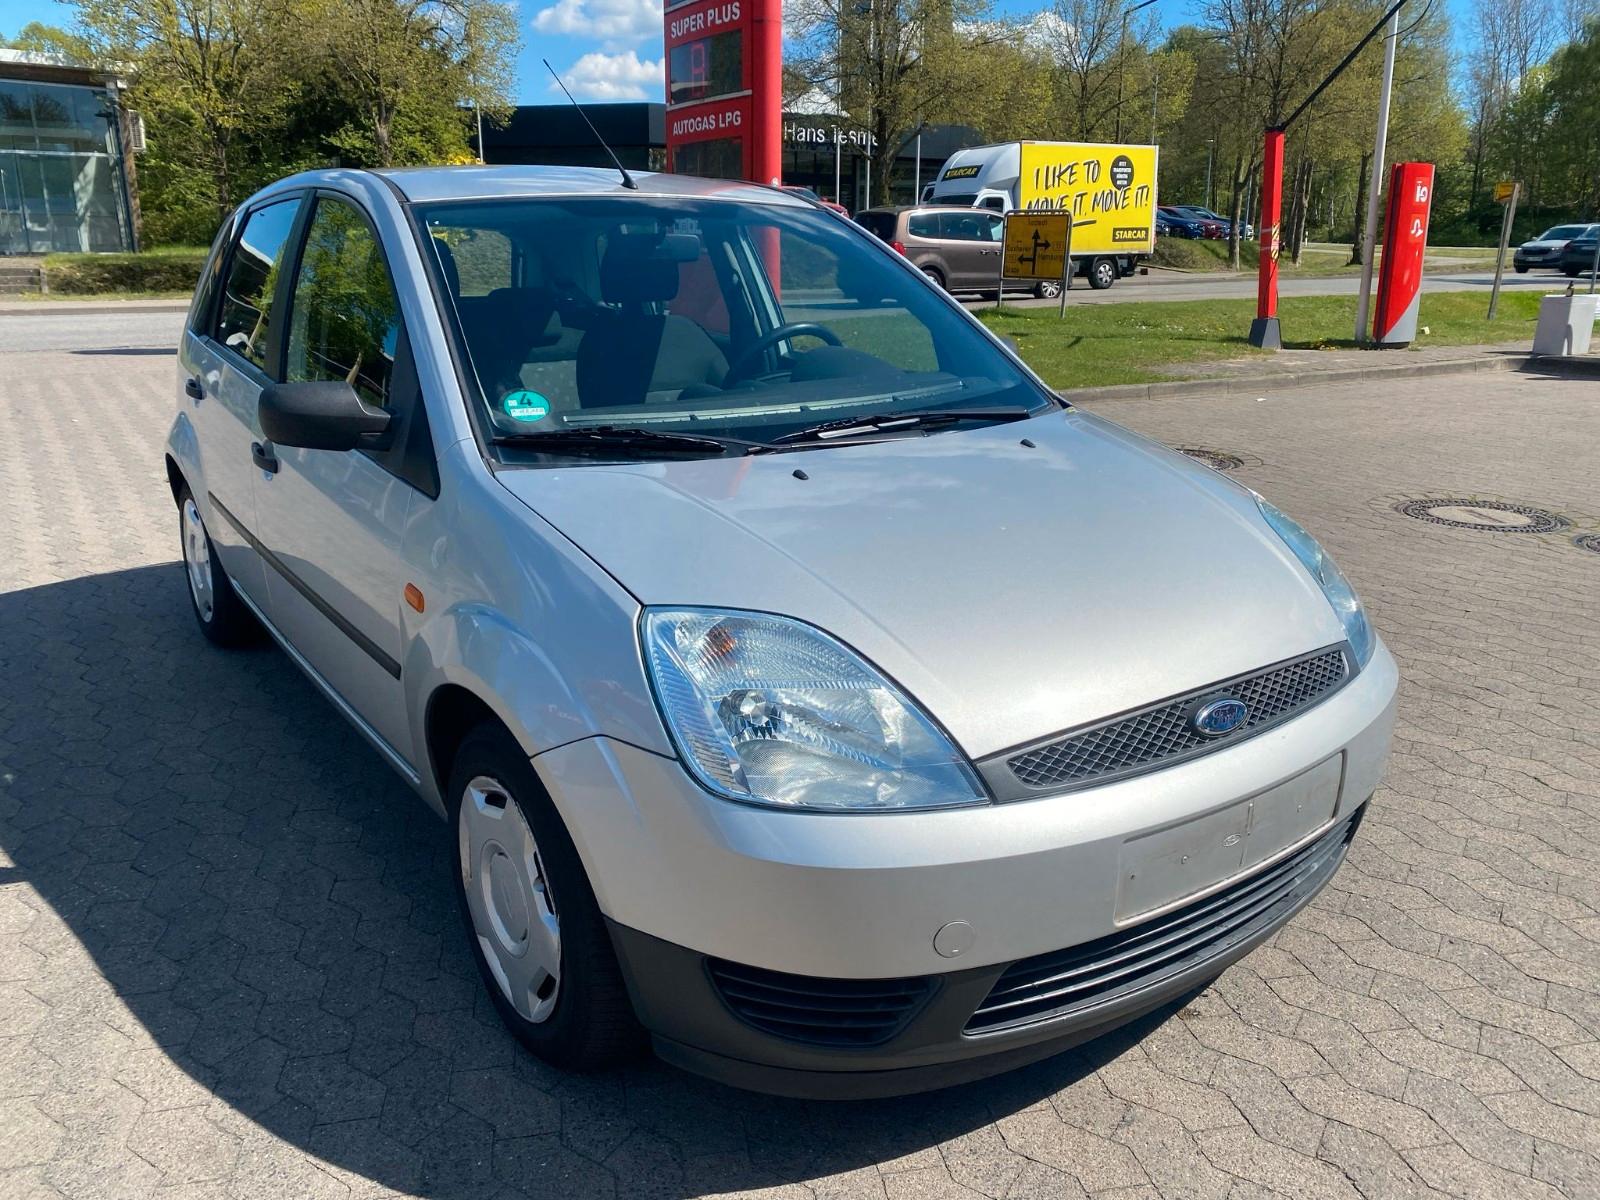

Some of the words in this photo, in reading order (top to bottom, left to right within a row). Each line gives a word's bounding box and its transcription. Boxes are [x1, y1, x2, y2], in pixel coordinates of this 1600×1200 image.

[671, 12, 704, 38] SUPER
[707, 2, 740, 27] PLUS
[673, 114, 716, 136] AUTOGAS
[719, 110, 741, 128] LPG
[784, 121, 825, 143] Hans
[1035, 168, 1040, 190] I
[1045, 163, 1079, 190] LIKE
[1083, 160, 1101, 184] TO
[1091, 187, 1131, 213] MOVE
[1134, 185, 1150, 208] IT!
[1115, 230, 1146, 239] STARCAR
[520, 393, 532, 406] 4
